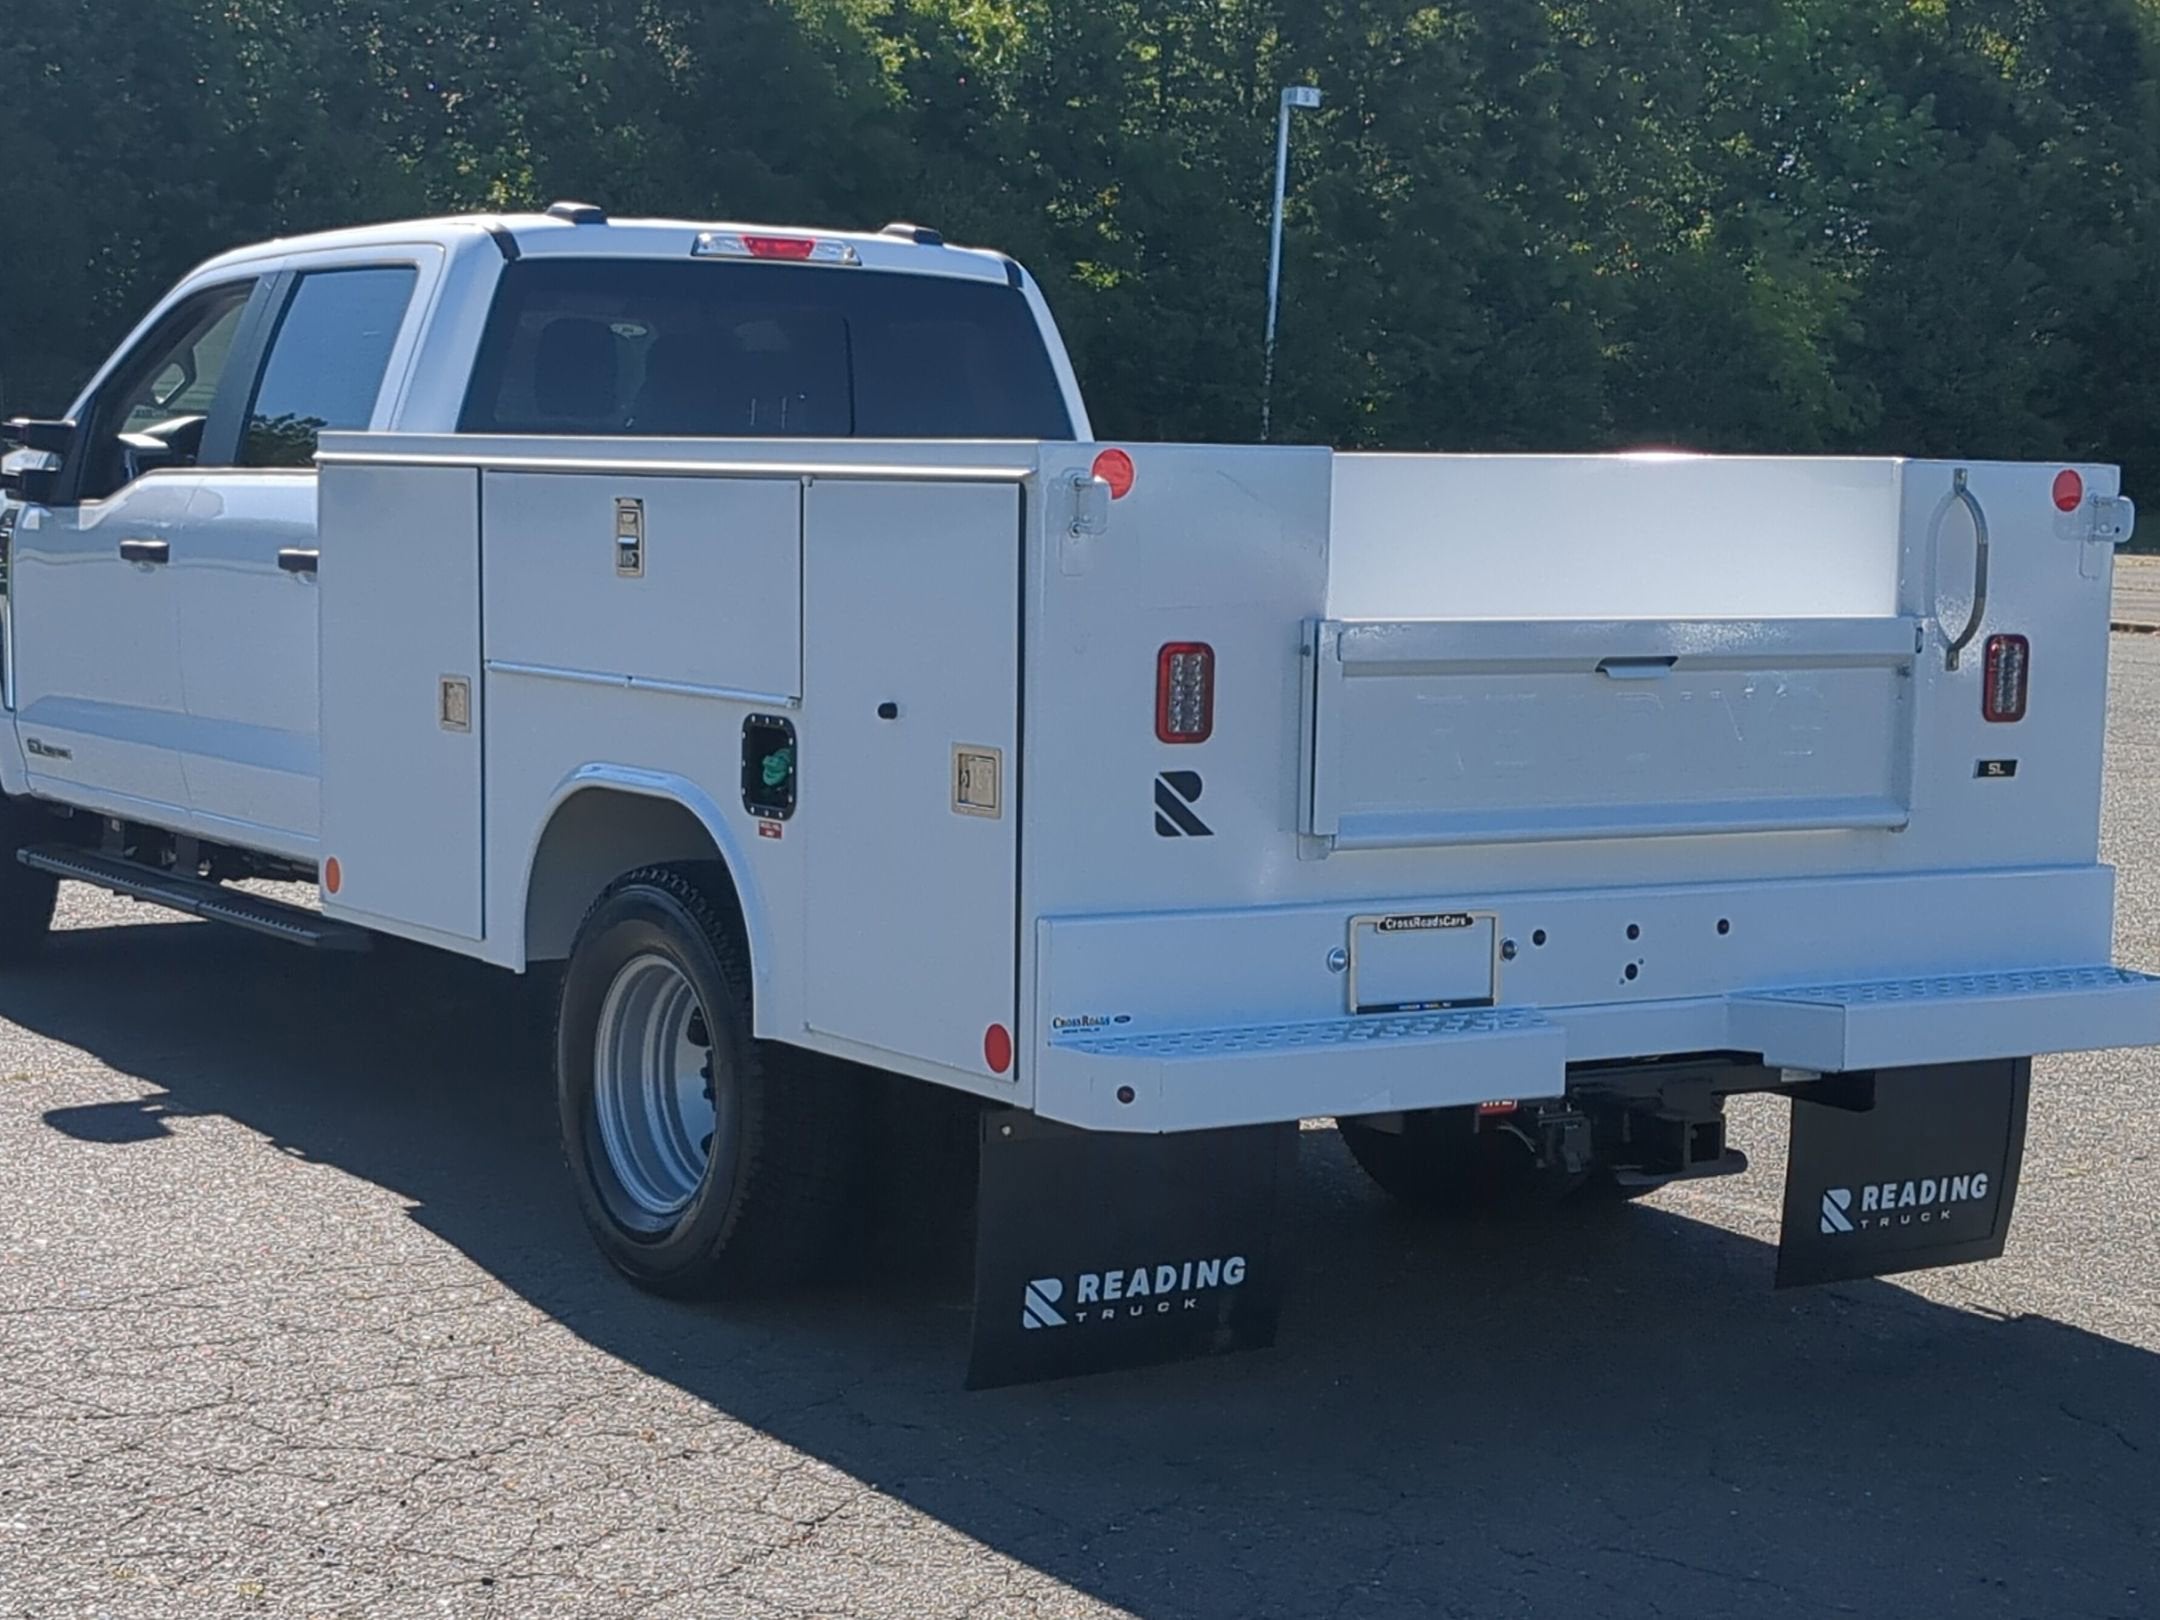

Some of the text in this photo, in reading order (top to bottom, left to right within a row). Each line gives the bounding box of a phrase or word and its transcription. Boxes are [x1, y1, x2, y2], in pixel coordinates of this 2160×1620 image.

[1402, 686, 1826, 780] REDING
[1987, 763, 2005, 775] SL
[1385, 915, 1466, 930] CrossRoadsCars
[1861, 1173, 1988, 1212] READING
[1860, 1210, 1951, 1230] TRUCK
[1077, 1256, 1247, 1304] READING
[1074, 1298, 1197, 1324] TRUCK
